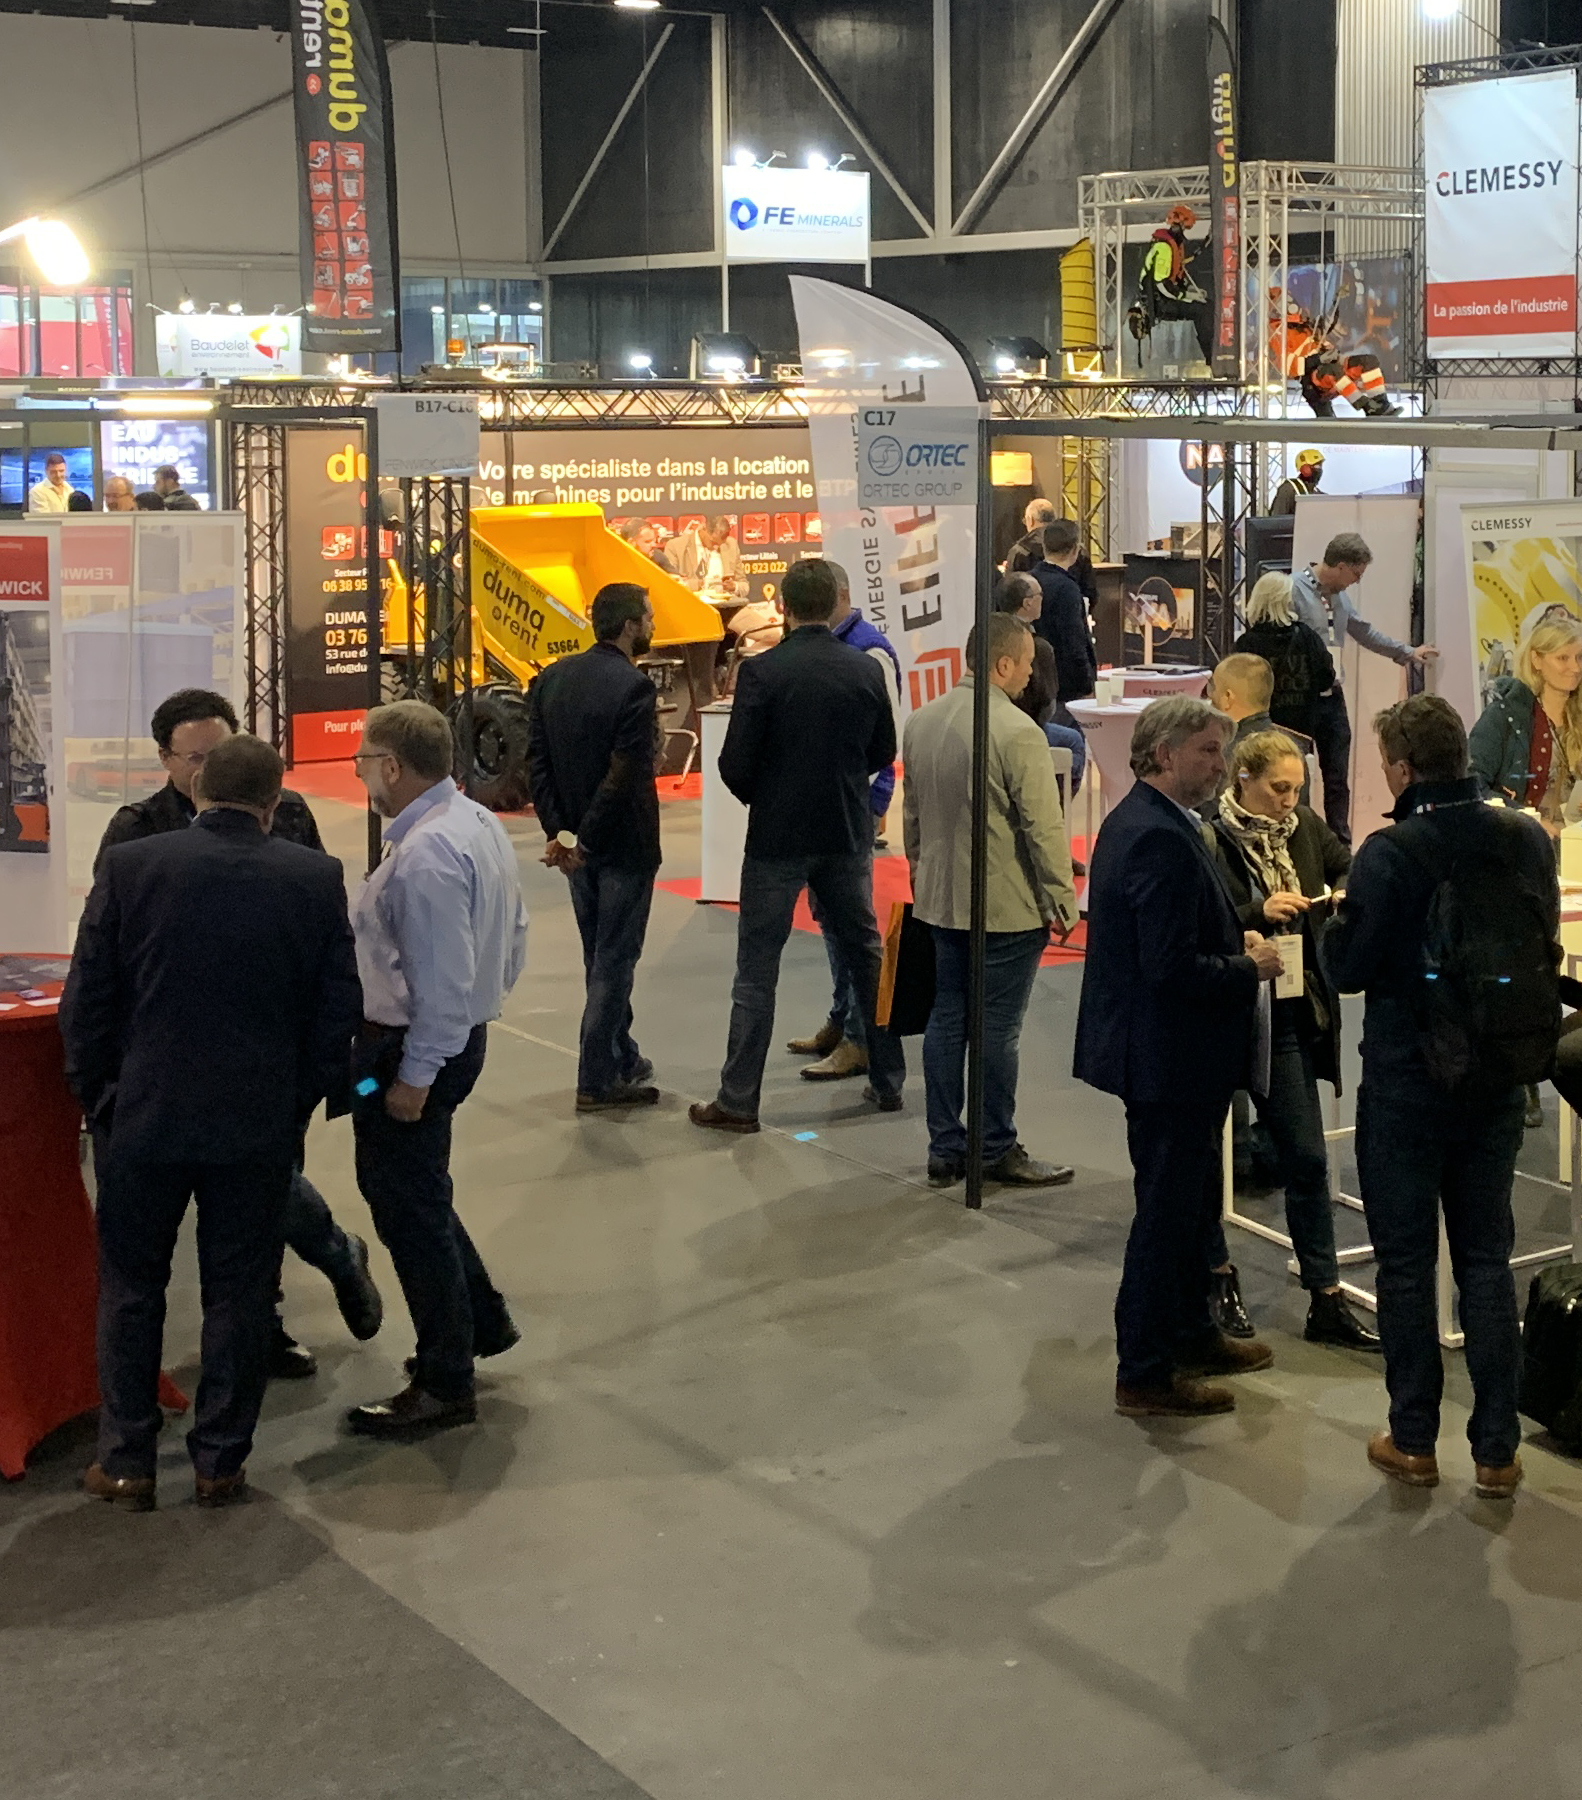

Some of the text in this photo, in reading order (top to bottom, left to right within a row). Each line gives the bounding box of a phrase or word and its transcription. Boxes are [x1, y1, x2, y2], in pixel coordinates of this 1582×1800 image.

[1436, 159, 1563, 197] CLEMESSY
[763, 206, 864, 228] FE MINERALS
[1433, 297, 1568, 320] La passion de l'industrie
[190, 339, 250, 351] Baudelet
[864, 410, 896, 426] C17
[906, 443, 969, 467] ORTEC
[479, 455, 810, 484] Vore spécialiste dans la location
[616, 486, 665, 508] pour
[670, 480, 768, 502] l'industrie
[772, 479, 793, 500] et
[796, 479, 814, 499] le
[863, 482, 963, 498] ORTEC GROUP
[1471, 517, 1532, 531] CLEMESSY
[770, 561, 787, 573] 022
[483, 570, 546, 632] duma
[325, 611, 367, 626] DUMA
[325, 628, 368, 647] 03 76
[325, 650, 338, 660] 53
[340, 651, 358, 660] rue
[324, 720, 348, 734] Pour
